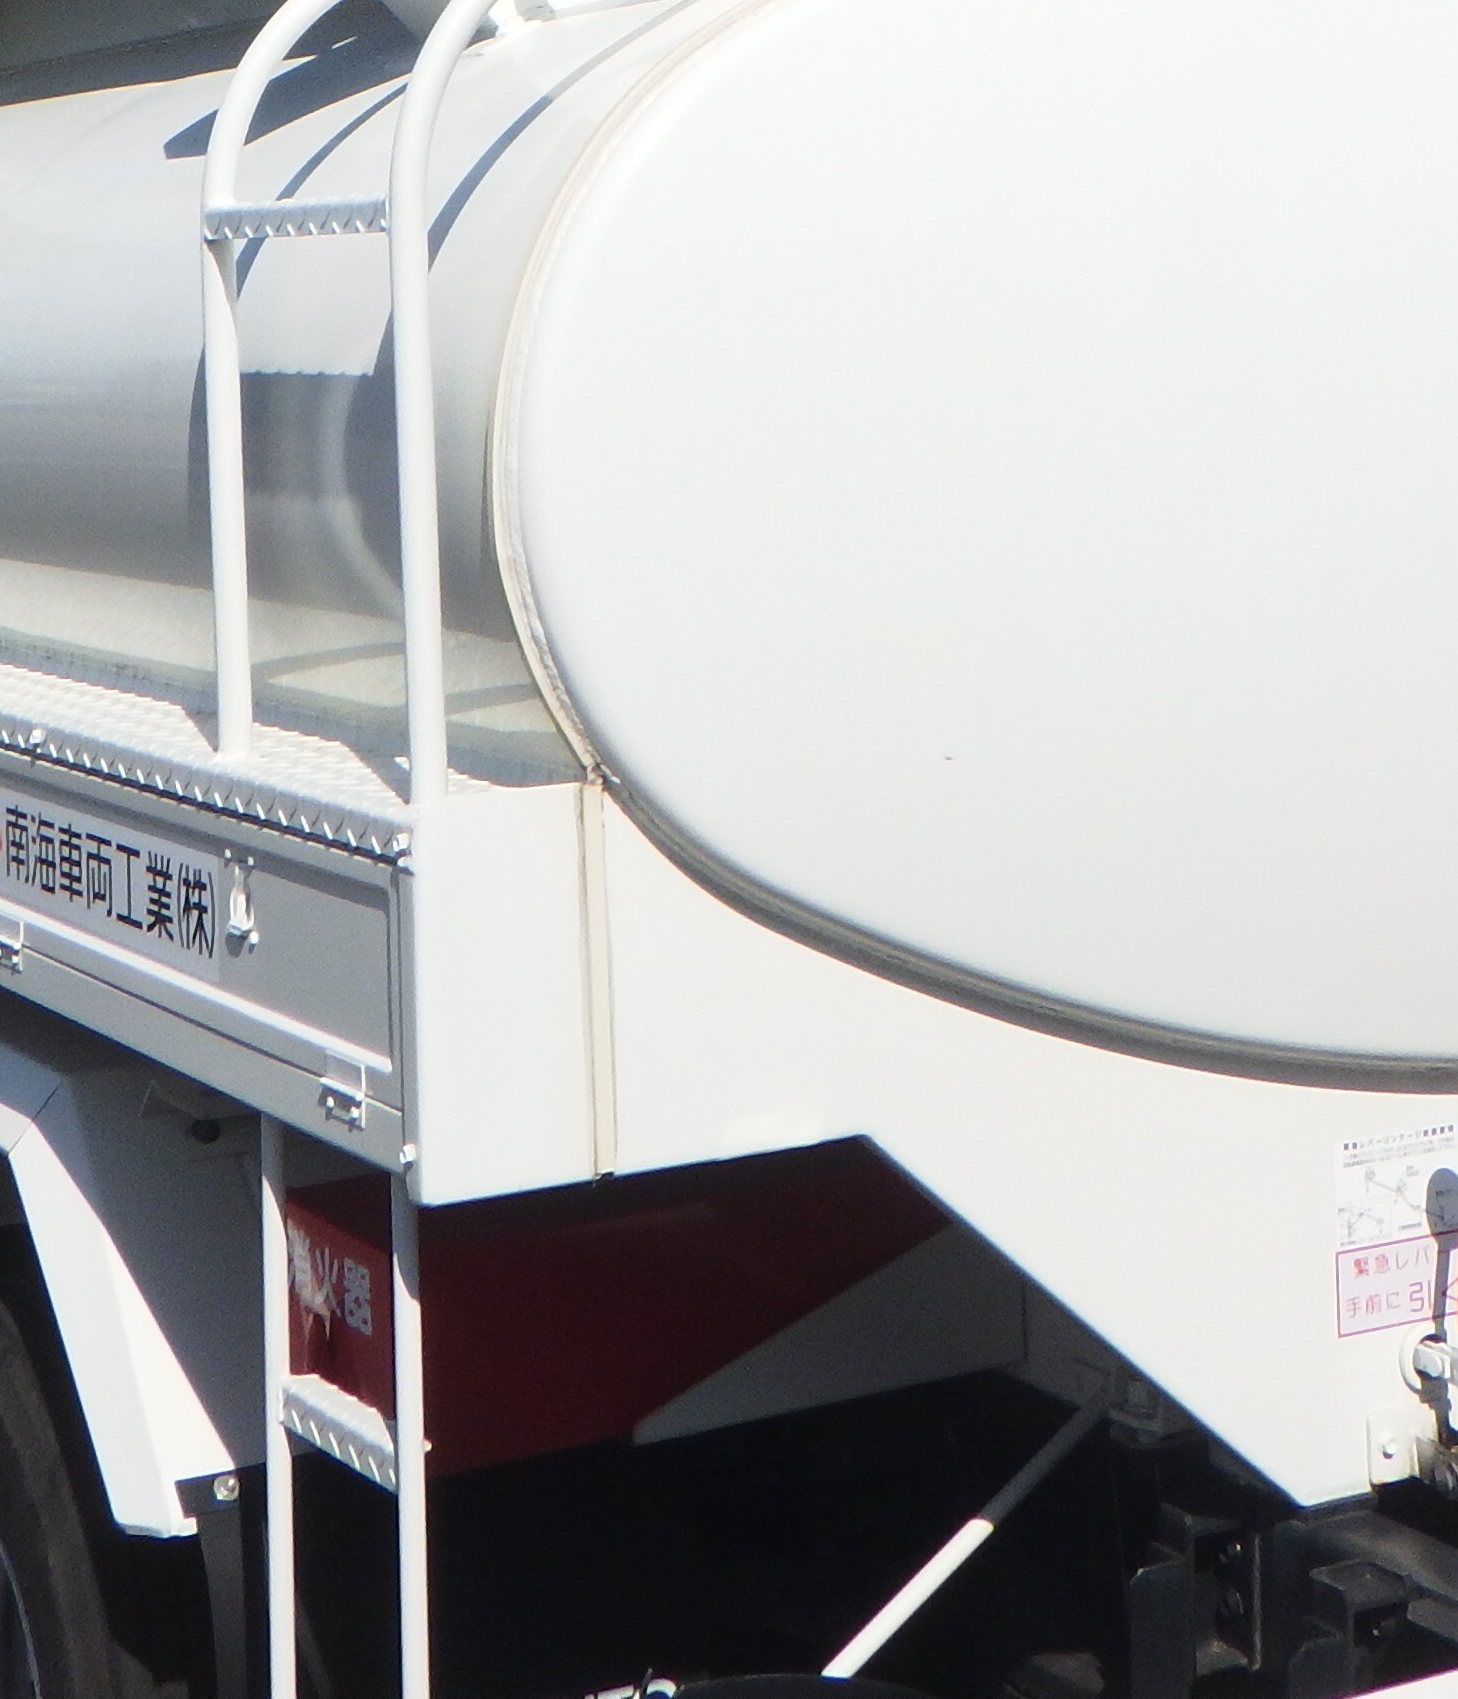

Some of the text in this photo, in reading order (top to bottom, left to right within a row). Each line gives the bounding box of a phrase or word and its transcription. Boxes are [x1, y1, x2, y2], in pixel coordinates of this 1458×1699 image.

[6, 805, 215, 958] 南海車両工業(株)
